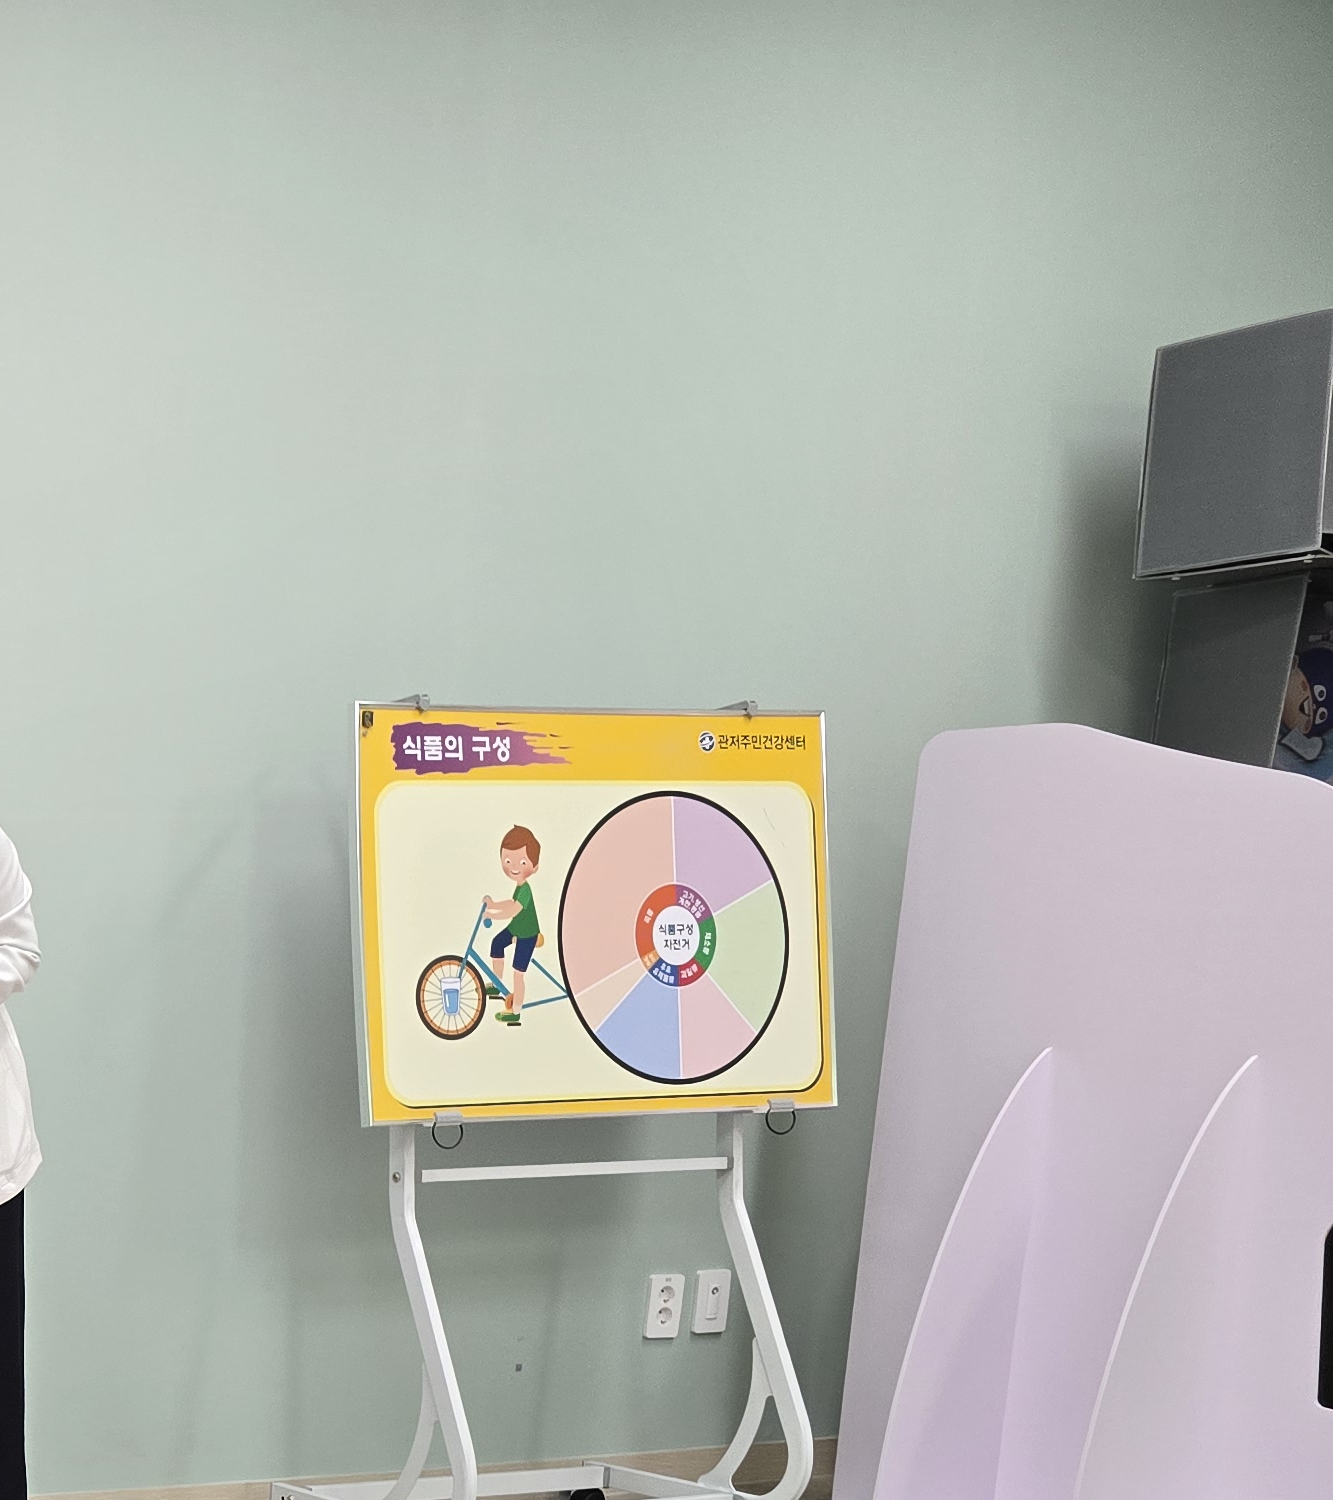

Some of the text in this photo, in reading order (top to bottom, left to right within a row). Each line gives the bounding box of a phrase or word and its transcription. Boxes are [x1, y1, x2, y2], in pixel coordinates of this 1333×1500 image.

[402, 735, 511, 763] 식품의 구성
[717, 734, 807, 751] 관저주민건강센터
[658, 924, 694, 936] 식품구성
[663, 939, 690, 950] 자전거
